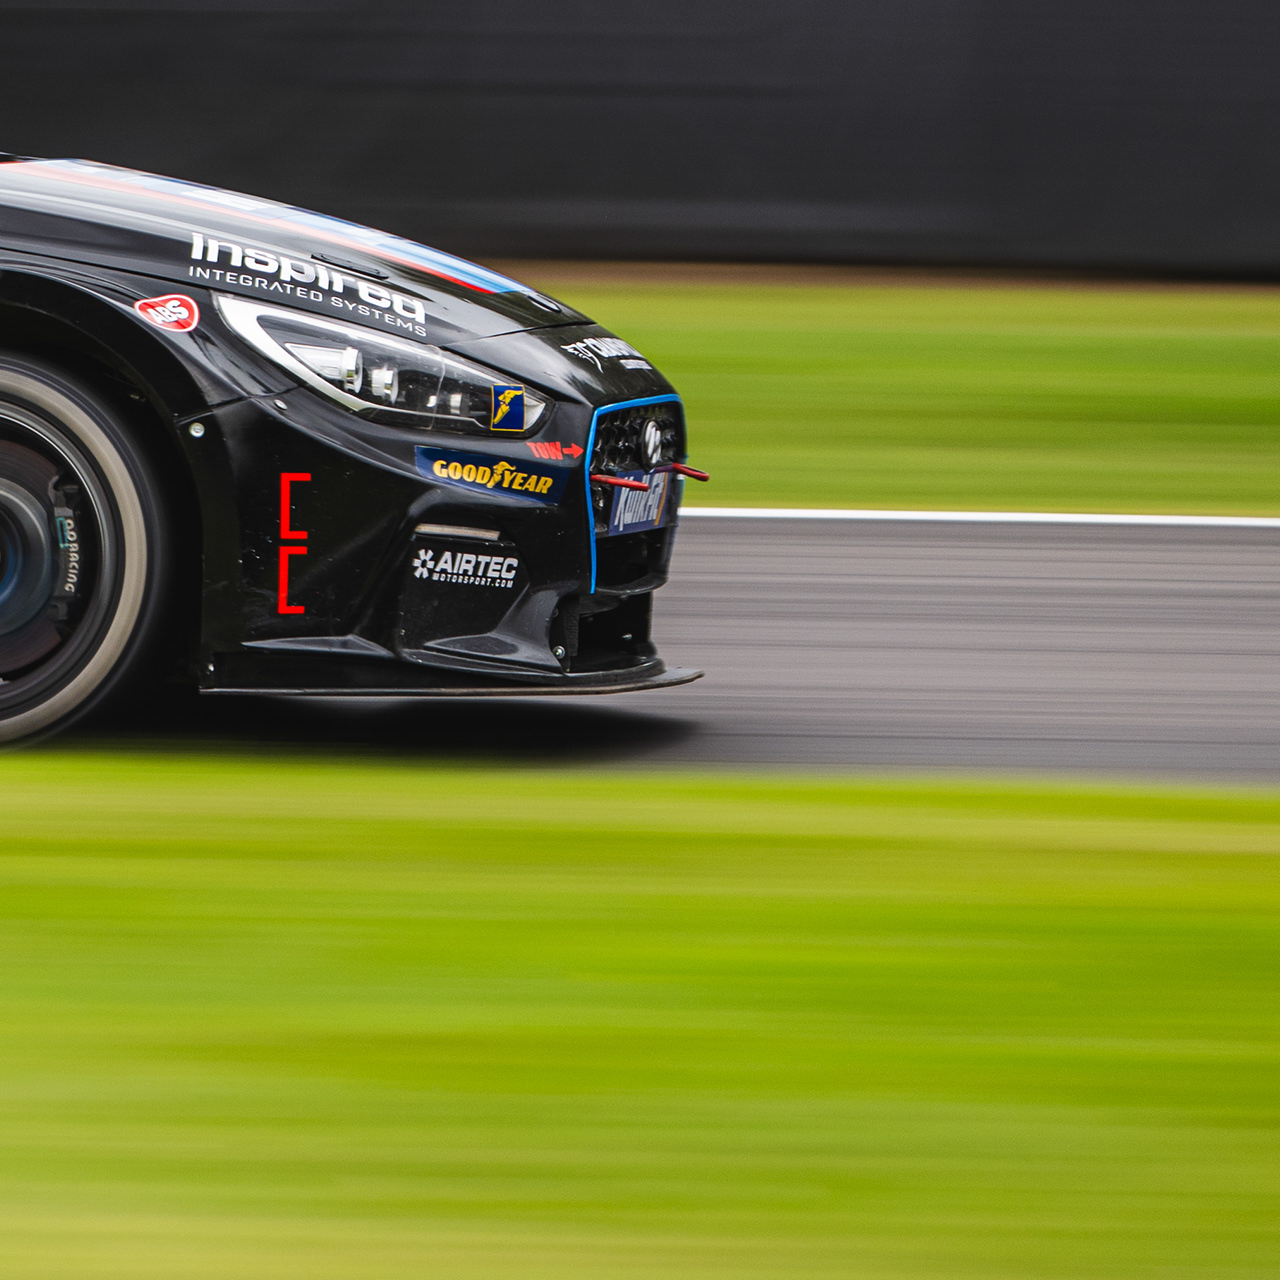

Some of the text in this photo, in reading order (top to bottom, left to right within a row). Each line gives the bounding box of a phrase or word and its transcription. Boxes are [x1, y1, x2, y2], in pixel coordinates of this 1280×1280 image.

[189, 266, 324, 302] INTEGRATED
[146, 300, 189, 325] ABS
[331, 297, 427, 337] SYSTEMS
[526, 441, 563, 460] TOW
[433, 460, 553, 494] GOODYEAR
[435, 551, 519, 579] AIRTEC
[432, 572, 514, 588] MOTORSPORT.COM
